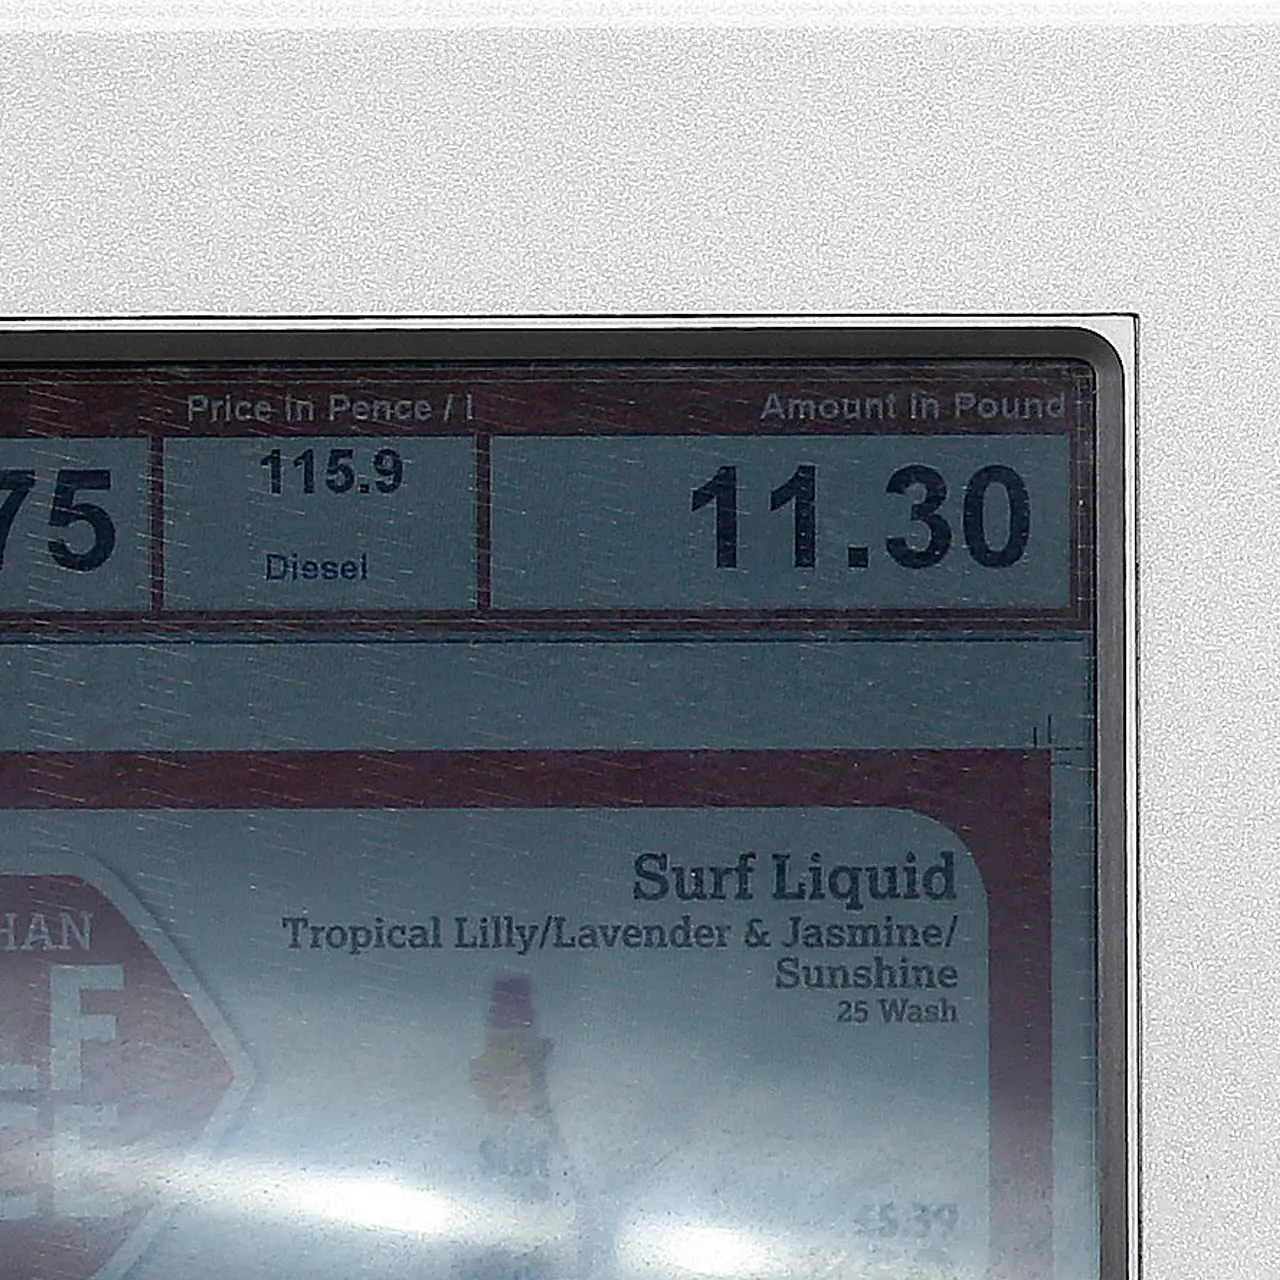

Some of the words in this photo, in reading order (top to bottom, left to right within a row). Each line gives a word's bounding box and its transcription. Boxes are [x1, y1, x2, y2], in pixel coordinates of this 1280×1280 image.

[187, 393, 272, 421] Price
[328, 393, 432, 421] Pence
[760, 392, 897, 420] Amount
[954, 391, 1066, 420] Pound
[260, 448, 404, 495] 115.9
[690, 464, 1032, 570] 11.30
[265, 552, 369, 581] Diesel
[633, 851, 757, 901] Surf
[771, 851, 958, 910] Liquid
[281, 916, 443, 955] Tropical
[454, 915, 732, 955] Lilly/Lavender
[744, 917, 772, 949] &
[781, 915, 959, 949] Jasmine/
[775, 956, 959, 990] Sunshine
[836, 999, 869, 1022] 25
[876, 998, 957, 1023] Wash
